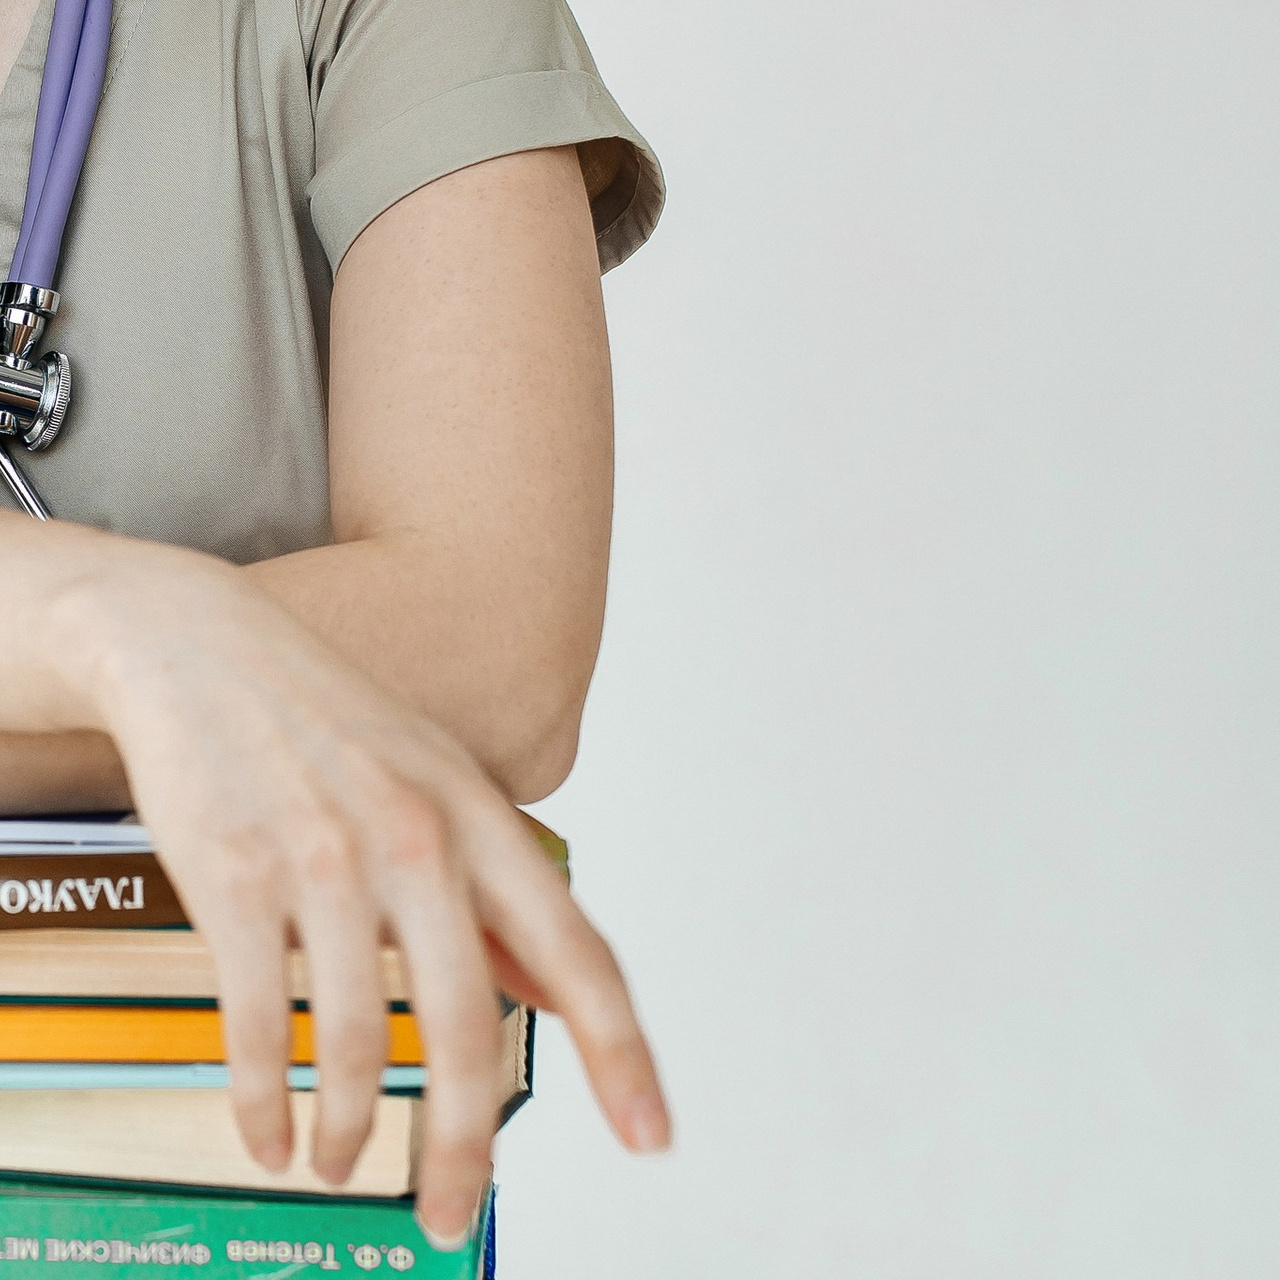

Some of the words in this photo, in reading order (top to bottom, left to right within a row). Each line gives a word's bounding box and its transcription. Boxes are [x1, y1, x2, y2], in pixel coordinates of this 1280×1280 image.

[44, 1238, 212, 1265] ФИЗИЧЕСКИЕ
[226, 1241, 341, 1270] Тетенев
[347, 1243, 415, 1271] Ф.Ф.
